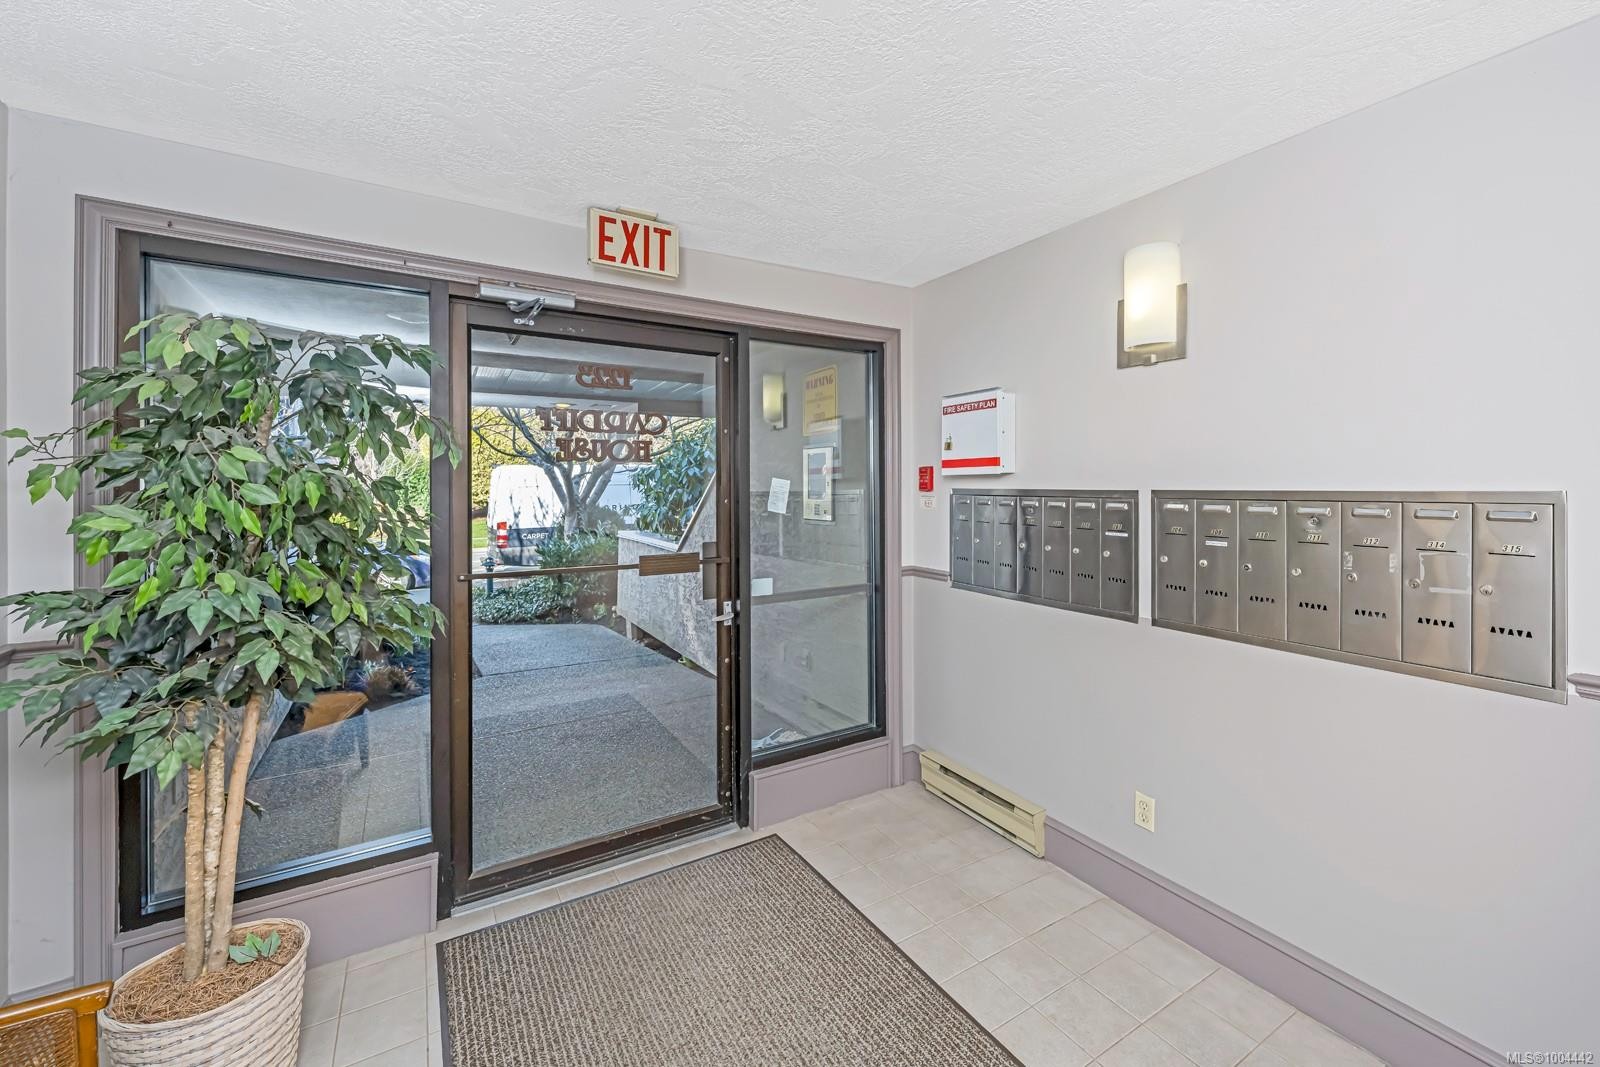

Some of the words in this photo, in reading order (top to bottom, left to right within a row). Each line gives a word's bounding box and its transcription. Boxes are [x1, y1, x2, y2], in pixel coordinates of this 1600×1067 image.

[598, 215, 672, 272] EXIT
[943, 406, 956, 415] FIRE
[956, 402, 979, 412] SAFETY
[979, 400, 996, 409] PLAN
[1427, 541, 1446, 549] 314
[1502, 545, 1523, 553] 315
